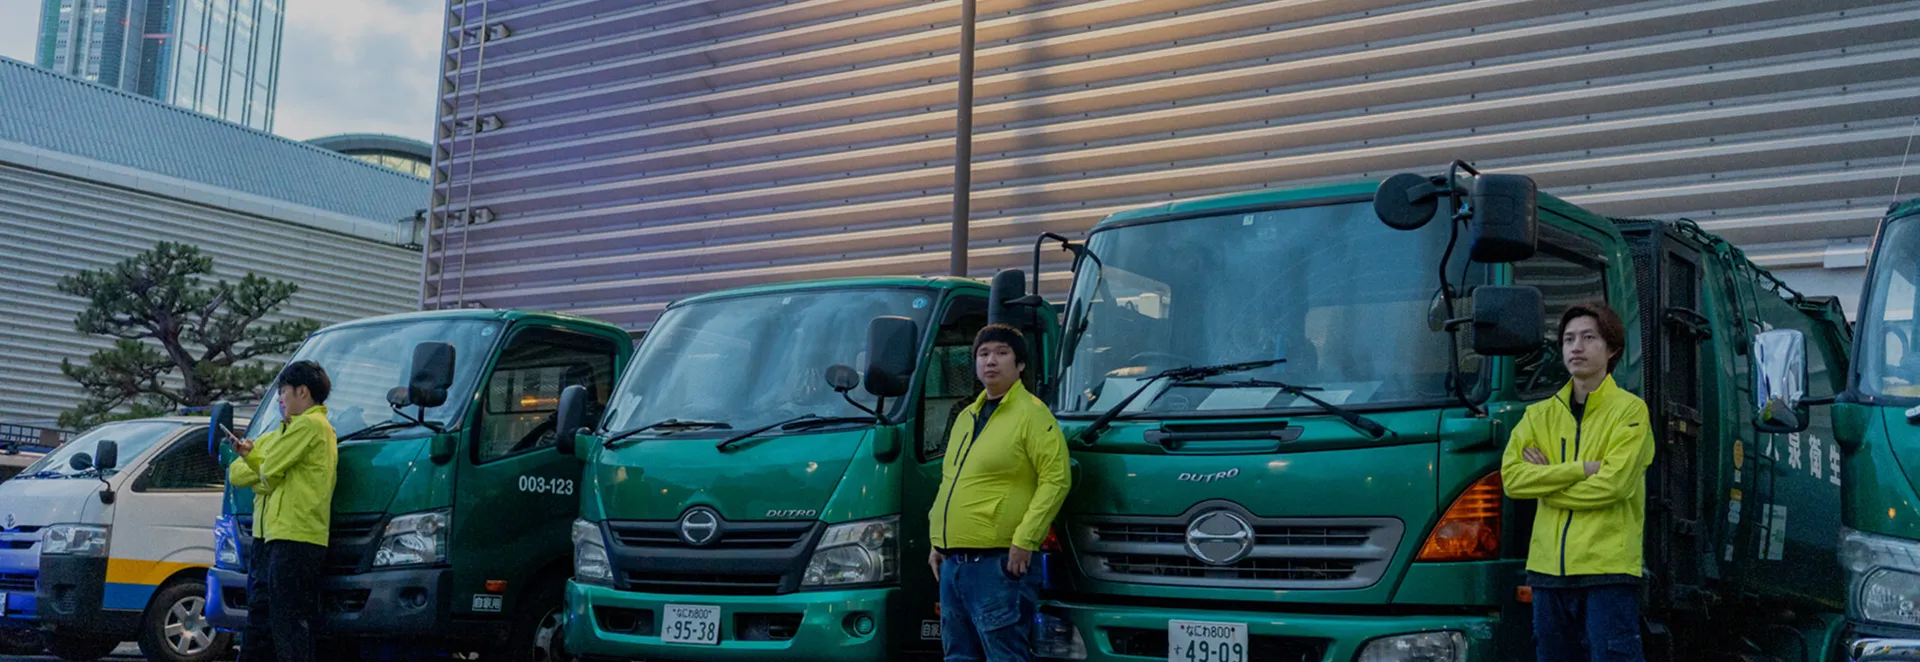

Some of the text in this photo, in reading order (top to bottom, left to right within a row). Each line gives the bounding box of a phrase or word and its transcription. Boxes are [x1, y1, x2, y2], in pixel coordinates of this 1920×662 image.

[1177, 467, 1240, 484] DUTRO
[518, 475, 574, 495] 003-123
[765, 508, 817, 517] DUTRO
[673, 620, 716, 641] 95-38
[923, 623, 941, 636] 自家
[1185, 625, 1231, 639] なにわ800
[1185, 640, 1243, 662] 49-09
